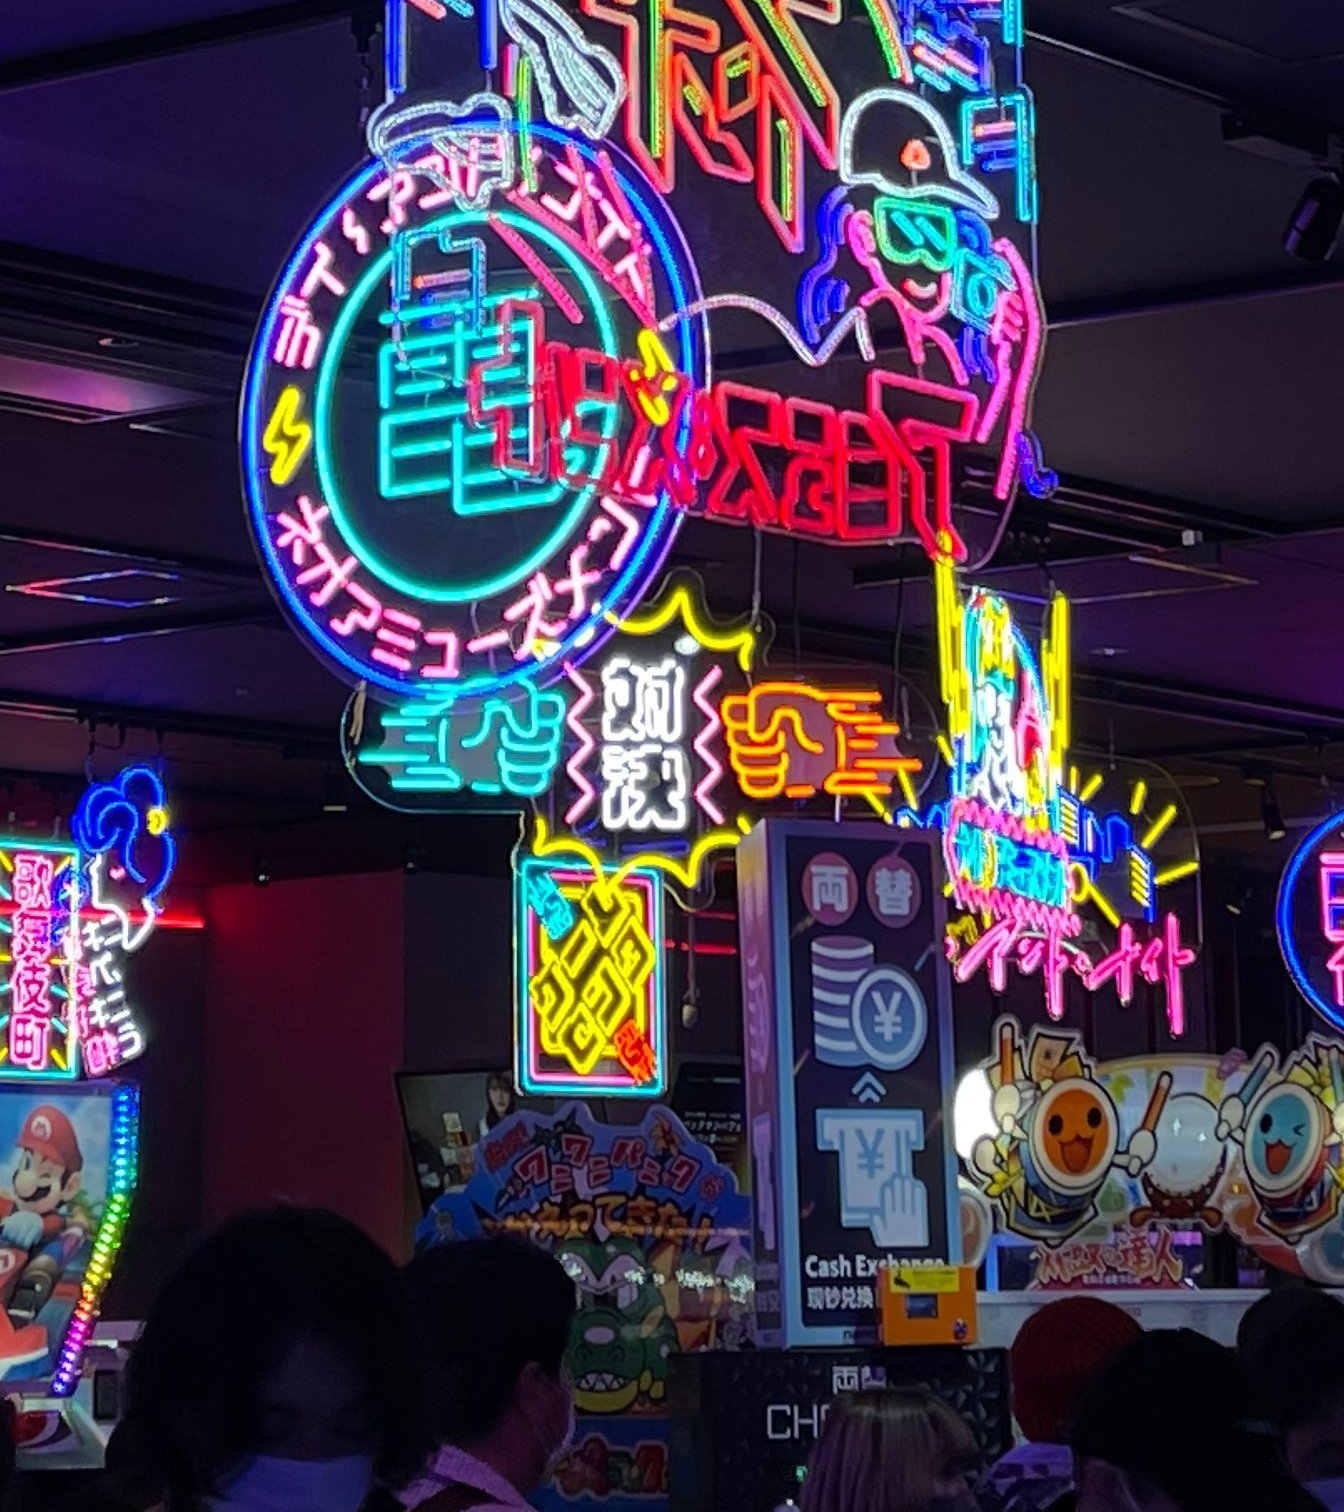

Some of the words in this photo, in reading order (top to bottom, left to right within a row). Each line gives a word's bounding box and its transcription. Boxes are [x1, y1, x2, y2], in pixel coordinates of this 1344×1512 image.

[811, 864, 913, 916] 両替
[10, 853, 53, 1070] 歌舞伎町
[805, 1254, 852, 1278] Cash
